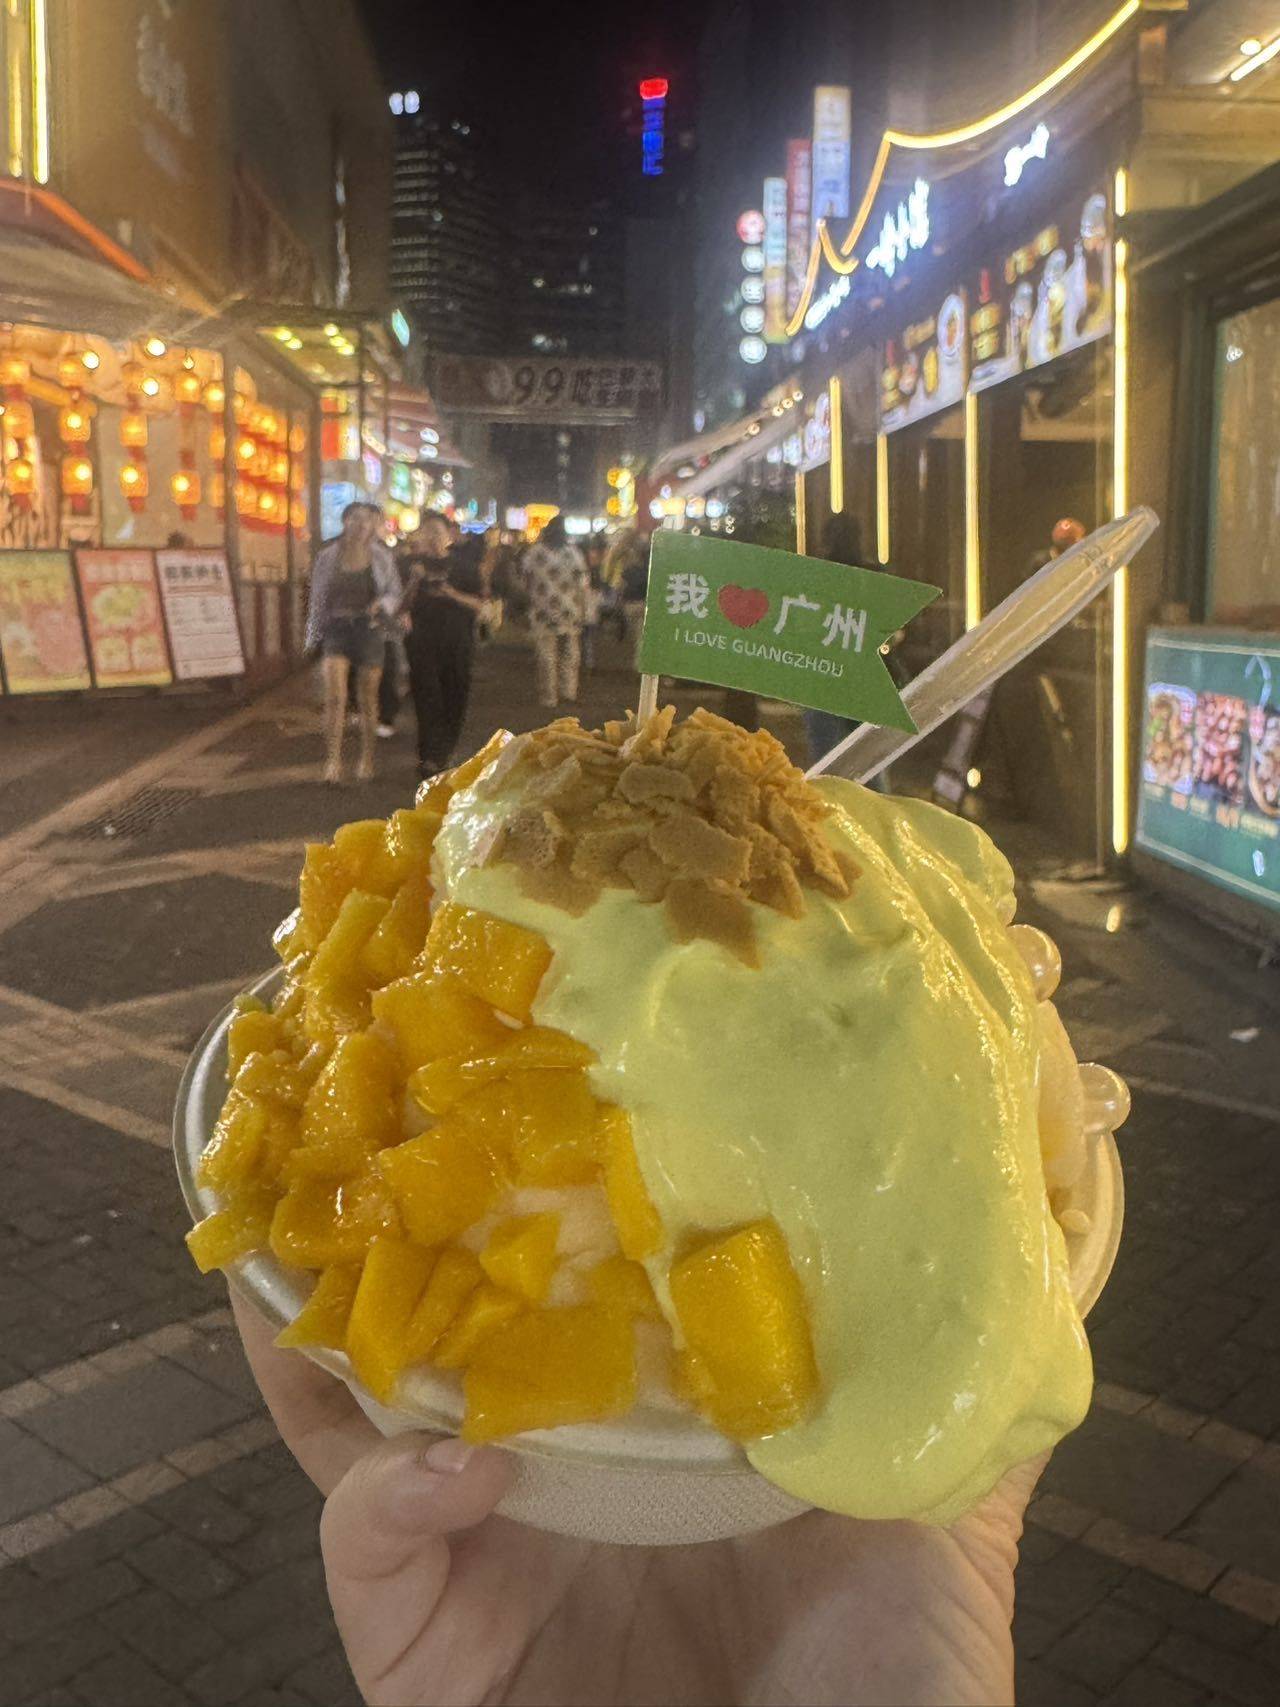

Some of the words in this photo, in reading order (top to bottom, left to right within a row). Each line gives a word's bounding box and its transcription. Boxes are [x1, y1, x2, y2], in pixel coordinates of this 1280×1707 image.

[666, 573, 709, 618] 我
[773, 594, 867, 653] 广州
[685, 631, 727, 651] LOVE
[732, 639, 845, 677] GUANGZHOU
